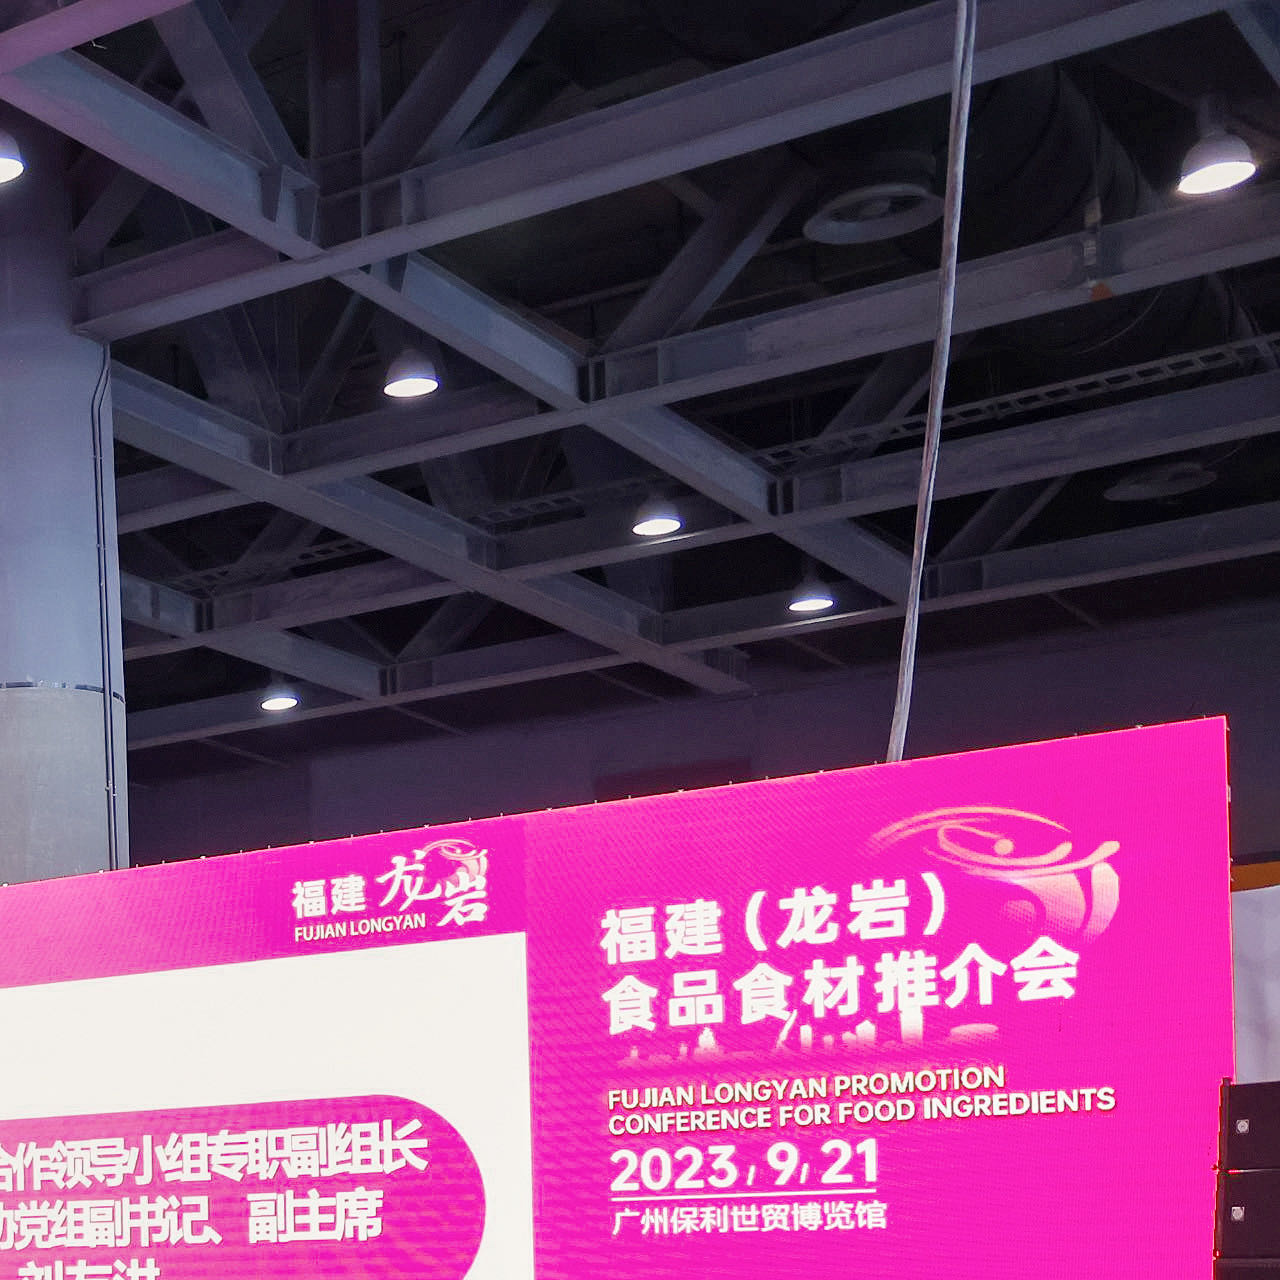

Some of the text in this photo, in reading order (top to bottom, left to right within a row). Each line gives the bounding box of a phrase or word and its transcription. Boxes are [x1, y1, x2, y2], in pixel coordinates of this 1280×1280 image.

[295, 913, 426, 942] FUJIAN LONGYAN
[599, 873, 946, 965] 福建（龙岩）
[601, 937, 1080, 1036] 食品食材推介会
[608, 1066, 1005, 1110] FUJIAN LONGYAN PROMOTION
[609, 1087, 1117, 1137] CONFERENCE FOR FOOD INGREDIENTS
[612, 1200, 887, 1237] 广州保利世贸博览馆
